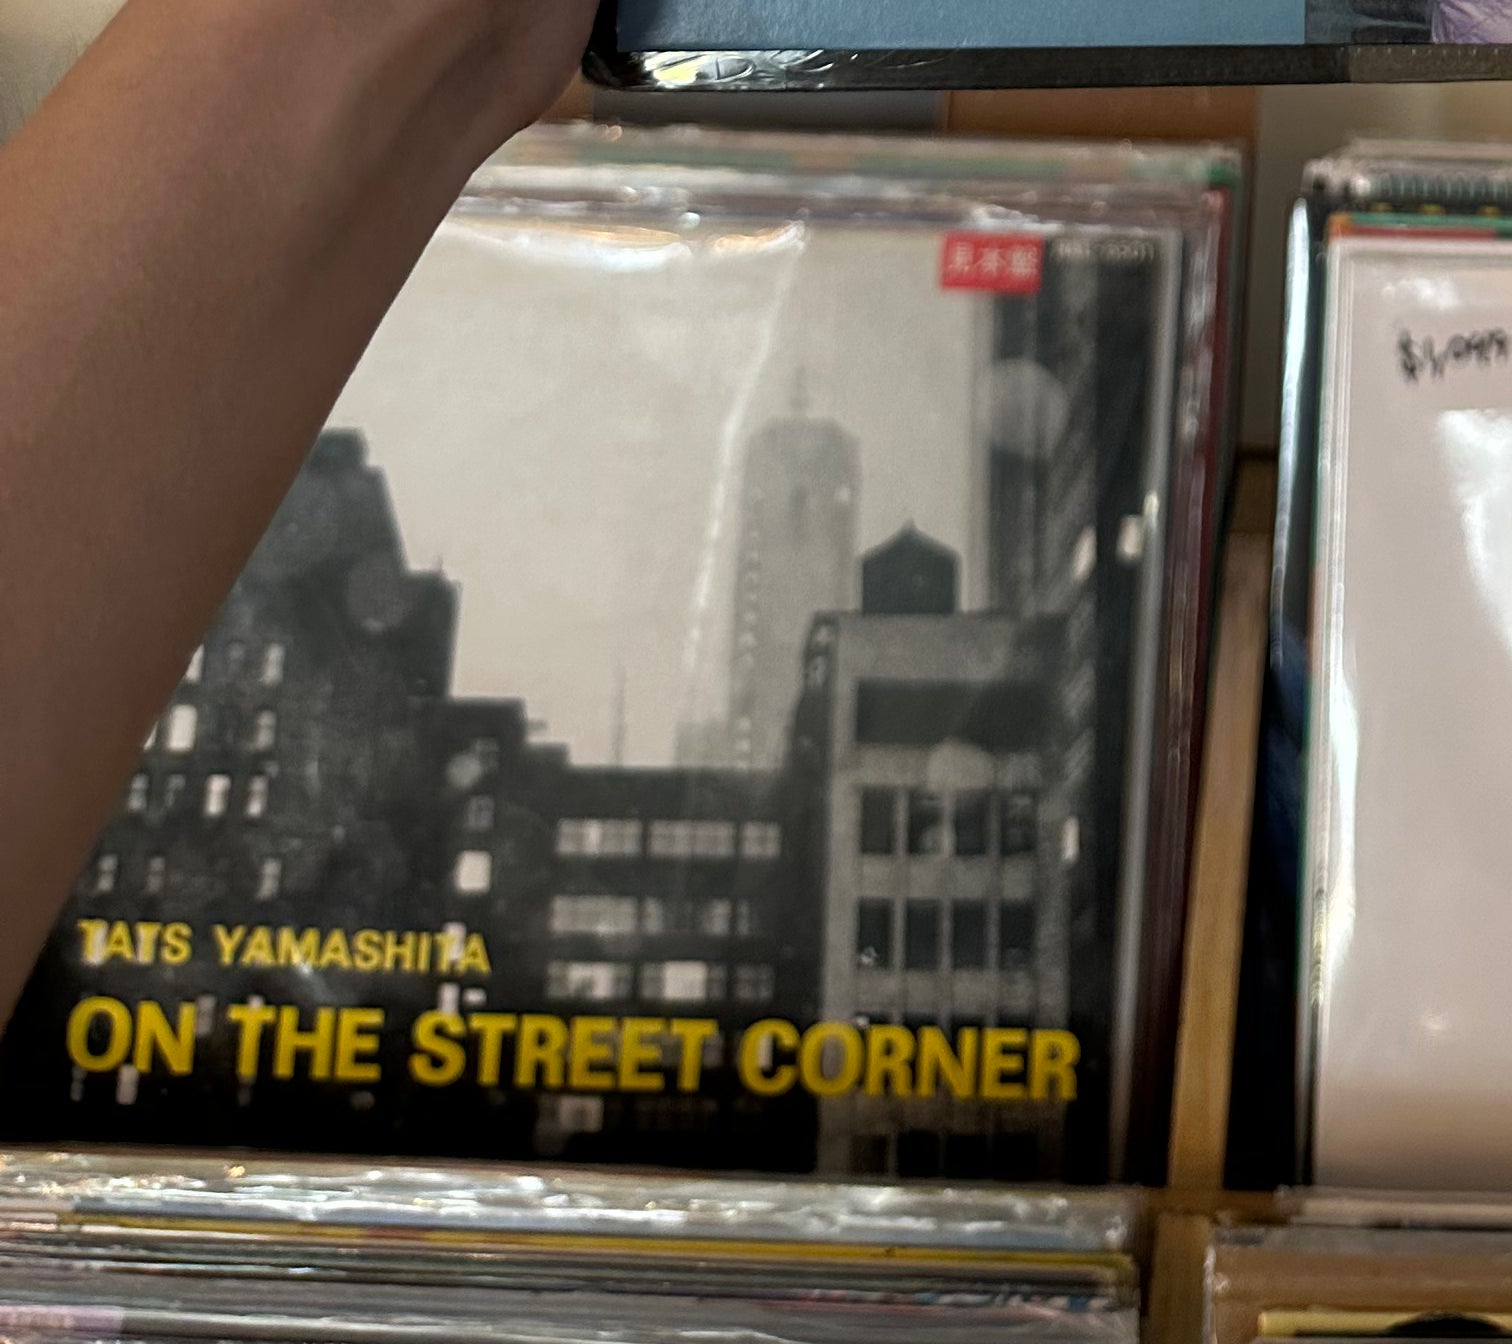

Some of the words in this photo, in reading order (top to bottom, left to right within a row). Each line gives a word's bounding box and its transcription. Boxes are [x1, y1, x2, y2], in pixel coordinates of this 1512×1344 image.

[77, 919, 191, 965] TATS
[214, 926, 492, 977] YAMASHITA
[65, 996, 195, 1074] ON
[230, 1004, 385, 1081] THE
[409, 1011, 716, 1093] STREET
[740, 1018, 1081, 1101] CORNER
